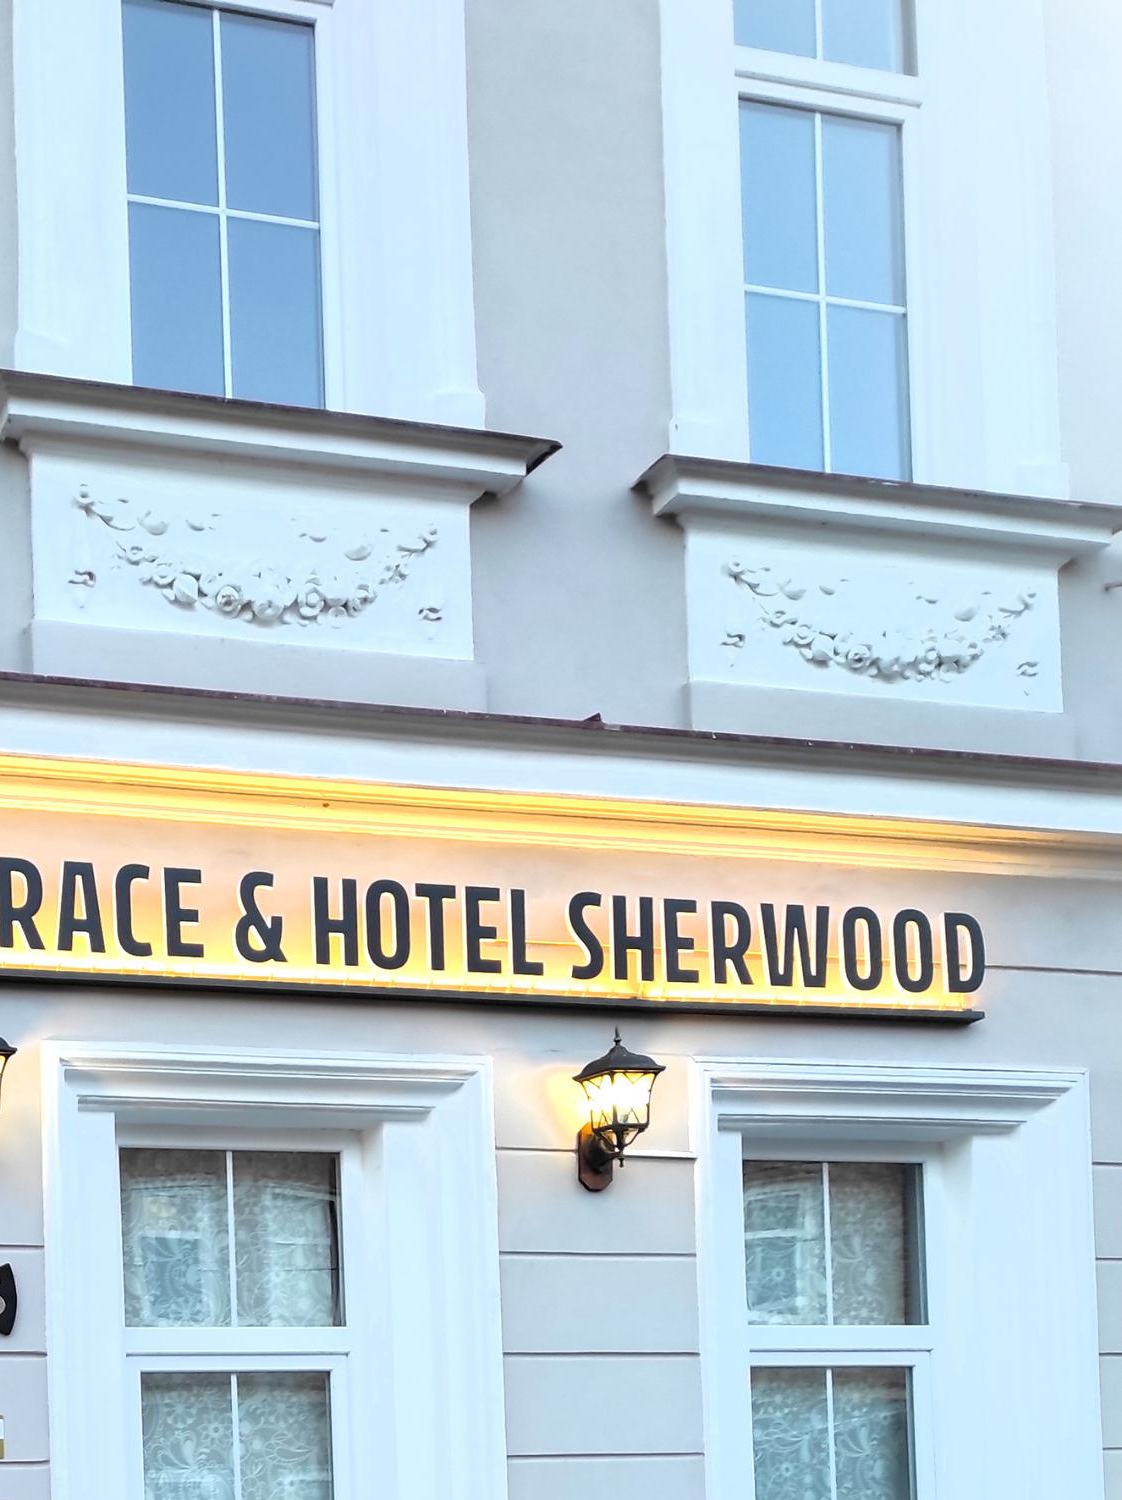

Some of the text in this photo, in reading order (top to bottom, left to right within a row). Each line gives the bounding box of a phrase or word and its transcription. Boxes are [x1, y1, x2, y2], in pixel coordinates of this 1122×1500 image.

[235, 870, 290, 963] &
[312, 875, 545, 977] HOTEL
[568, 891, 987, 994] SHERWOOD
